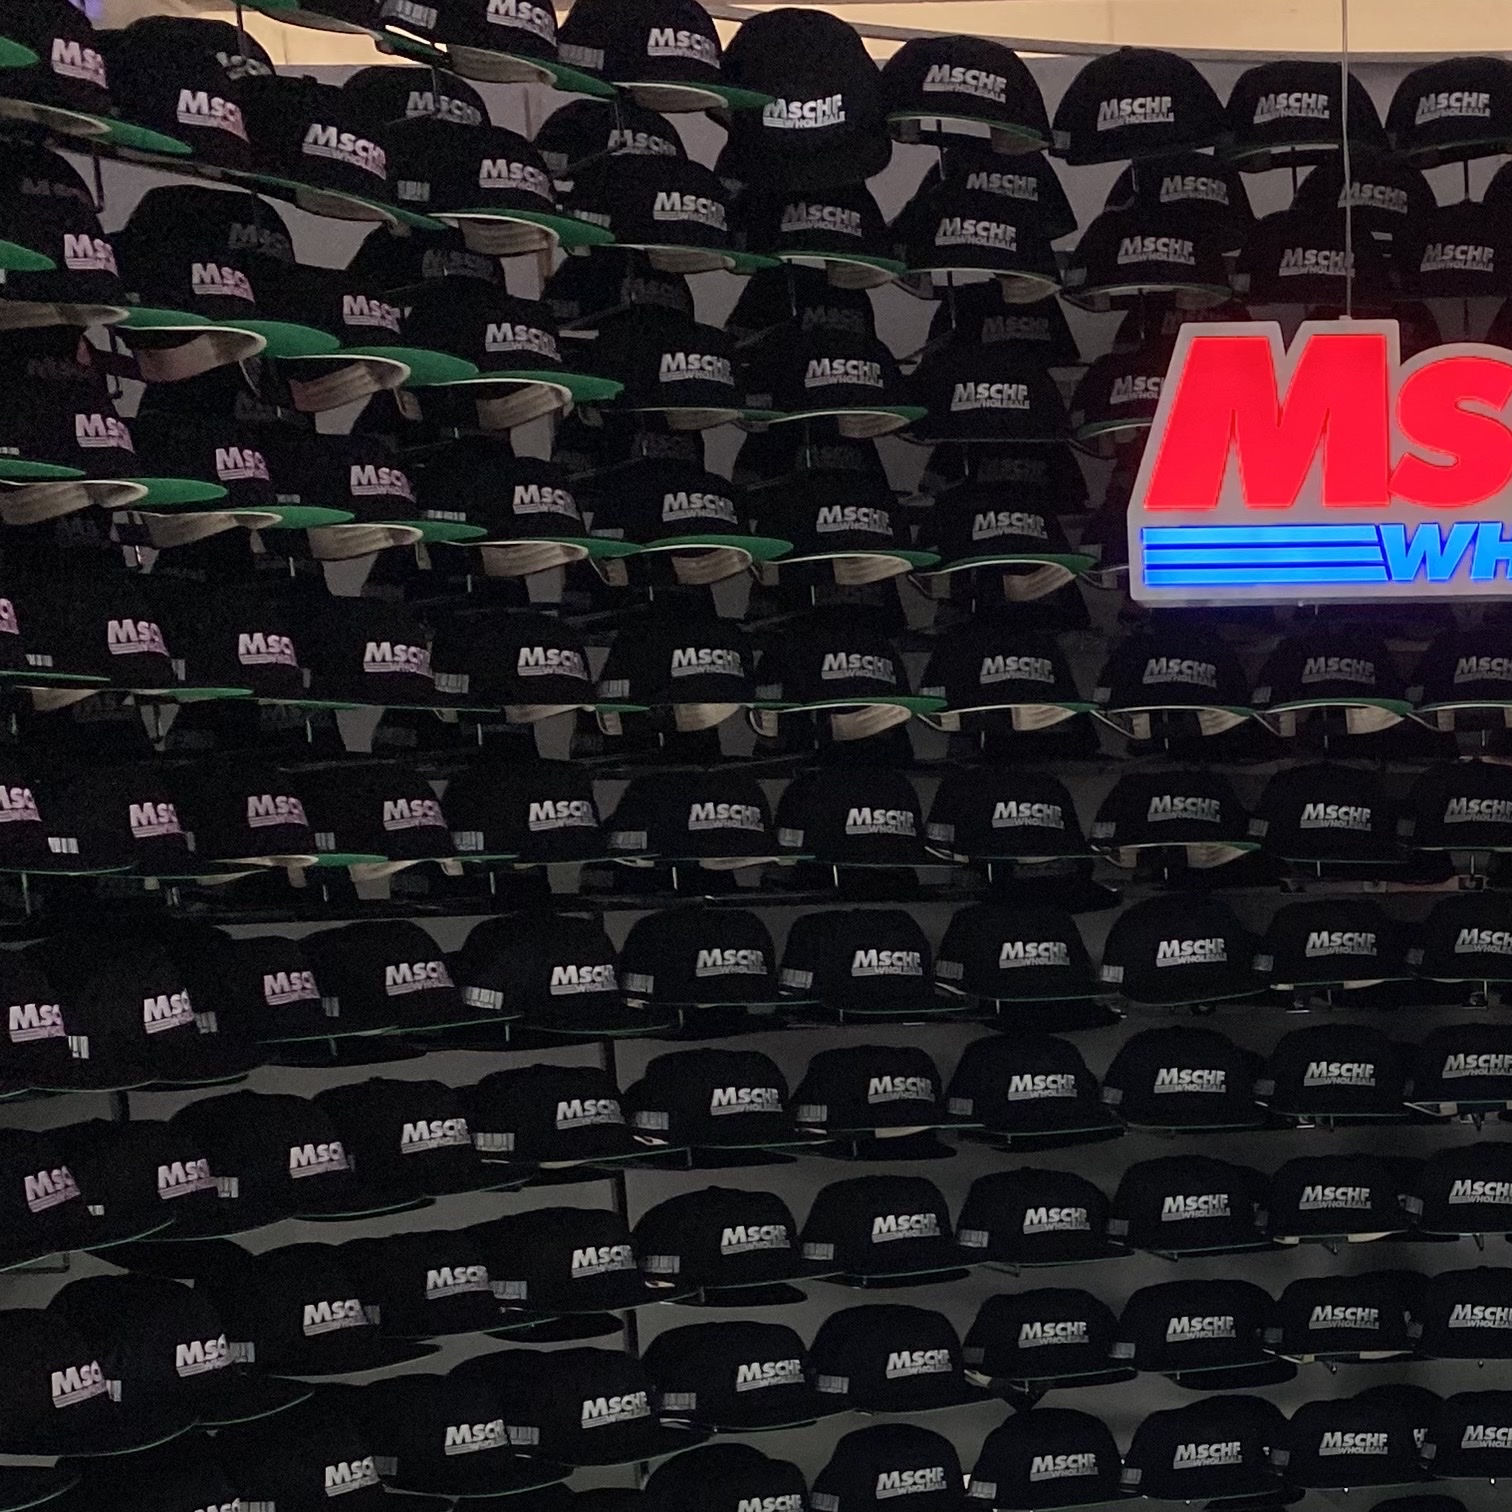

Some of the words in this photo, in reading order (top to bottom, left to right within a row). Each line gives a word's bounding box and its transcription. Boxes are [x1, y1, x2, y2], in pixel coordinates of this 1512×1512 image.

[927, 64, 1006, 94] MSCHF
[764, 94, 843, 119] MSCHF
[1099, 96, 1174, 121] MSCHF
[1257, 92, 1328, 115] MSCHF
[1418, 92, 1490, 116] MSCHF
[785, 202, 861, 229] MSCHF
[937, 217, 1015, 243] MSCHF
[1119, 236, 1193, 259] MSCHF
[1424, 243, 1494, 265] MSCHF
[953, 382, 1028, 405] MSCHF
[1150, 795, 1220, 813] MSCHF
[1302, 803, 1371, 822] MSCHF
[1155, 1068, 1225, 1088] MSCHF
[1305, 1061, 1374, 1081] MSCHF
[1163, 1194, 1228, 1213] MSCHF
[1301, 1185, 1370, 1204] MSCHF
[1168, 1316, 1233, 1334] MSCHF
[1311, 1305, 1379, 1325] MSCHF
[1020, 1321, 1086, 1340] MSCHF
[1175, 1442, 1241, 1461] MSCHF
[1321, 1432, 1388, 1451] MSCHF
[1032, 1453, 1097, 1473] MSCHF
